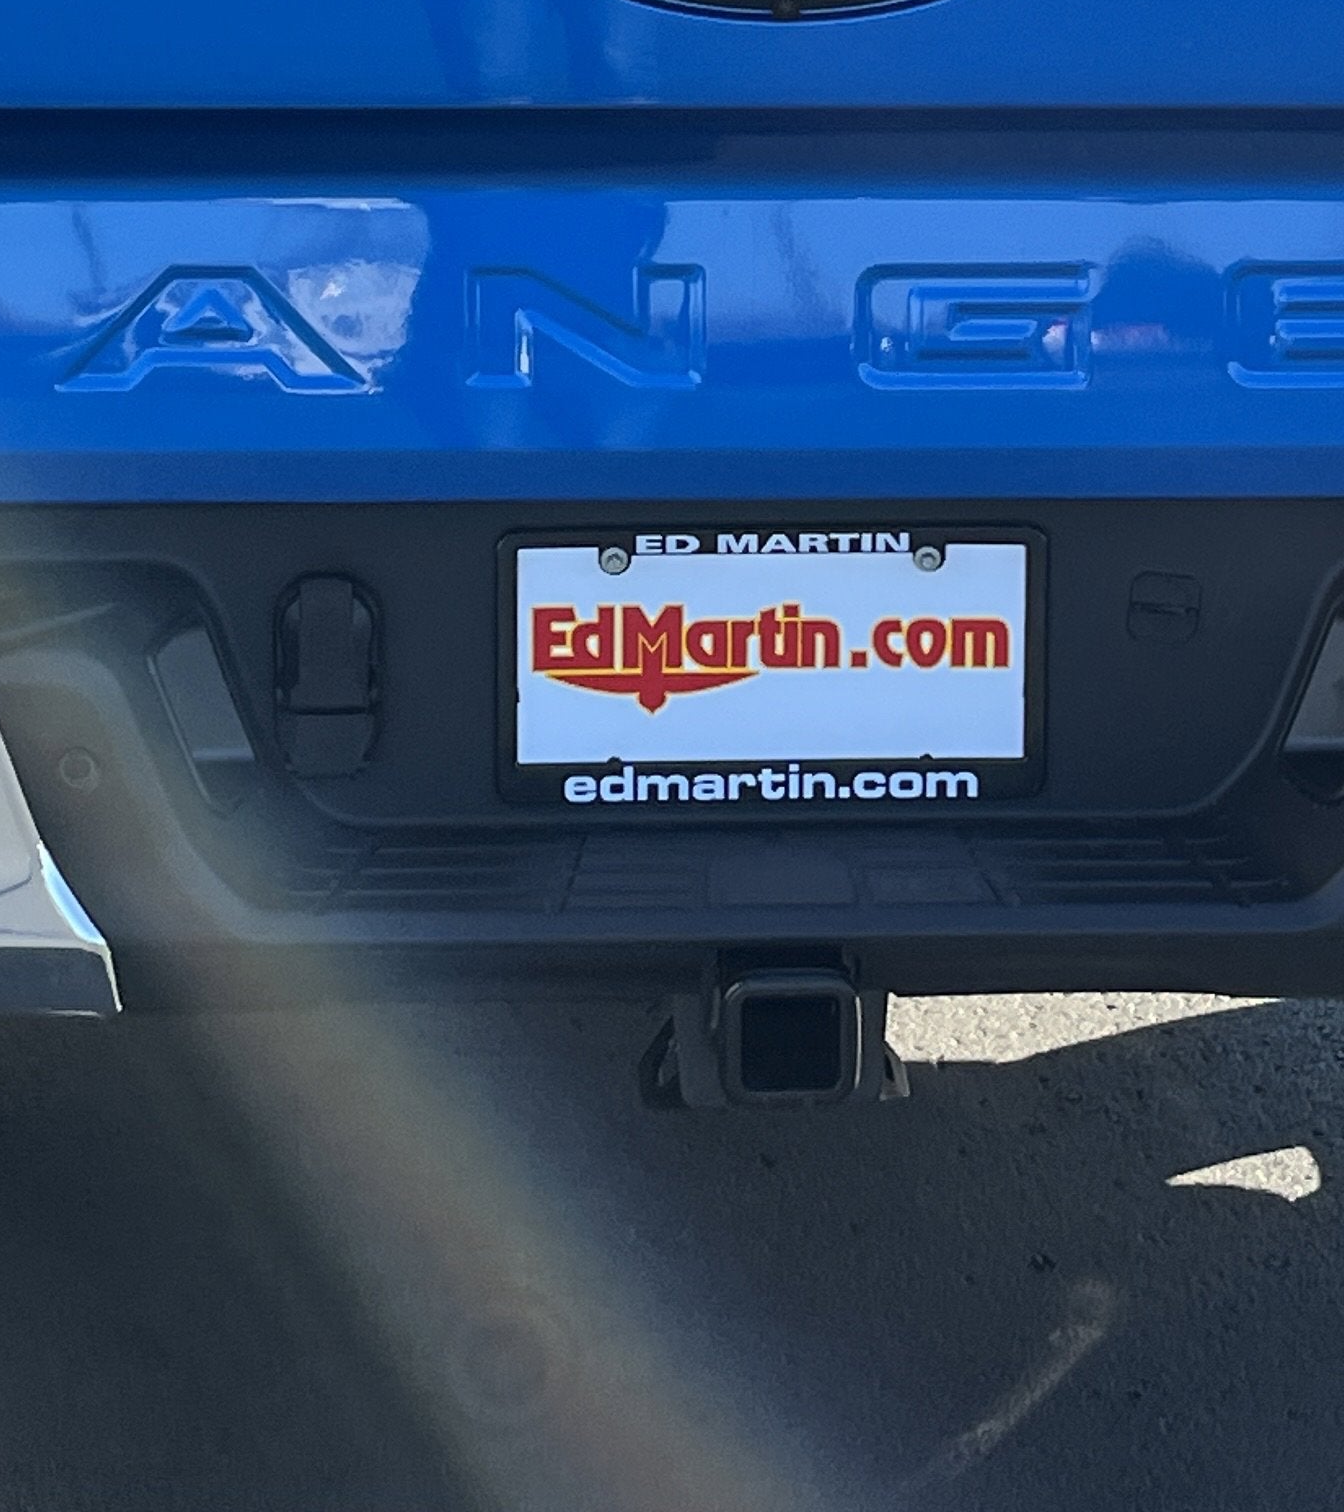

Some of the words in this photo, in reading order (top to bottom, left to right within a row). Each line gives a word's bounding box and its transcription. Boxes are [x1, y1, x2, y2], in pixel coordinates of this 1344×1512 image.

[634, 534, 700, 555] ED
[716, 532, 911, 555] MARTIN
[530, 601, 1011, 674] EdMartin.com
[563, 764, 980, 804] edmartin.com
